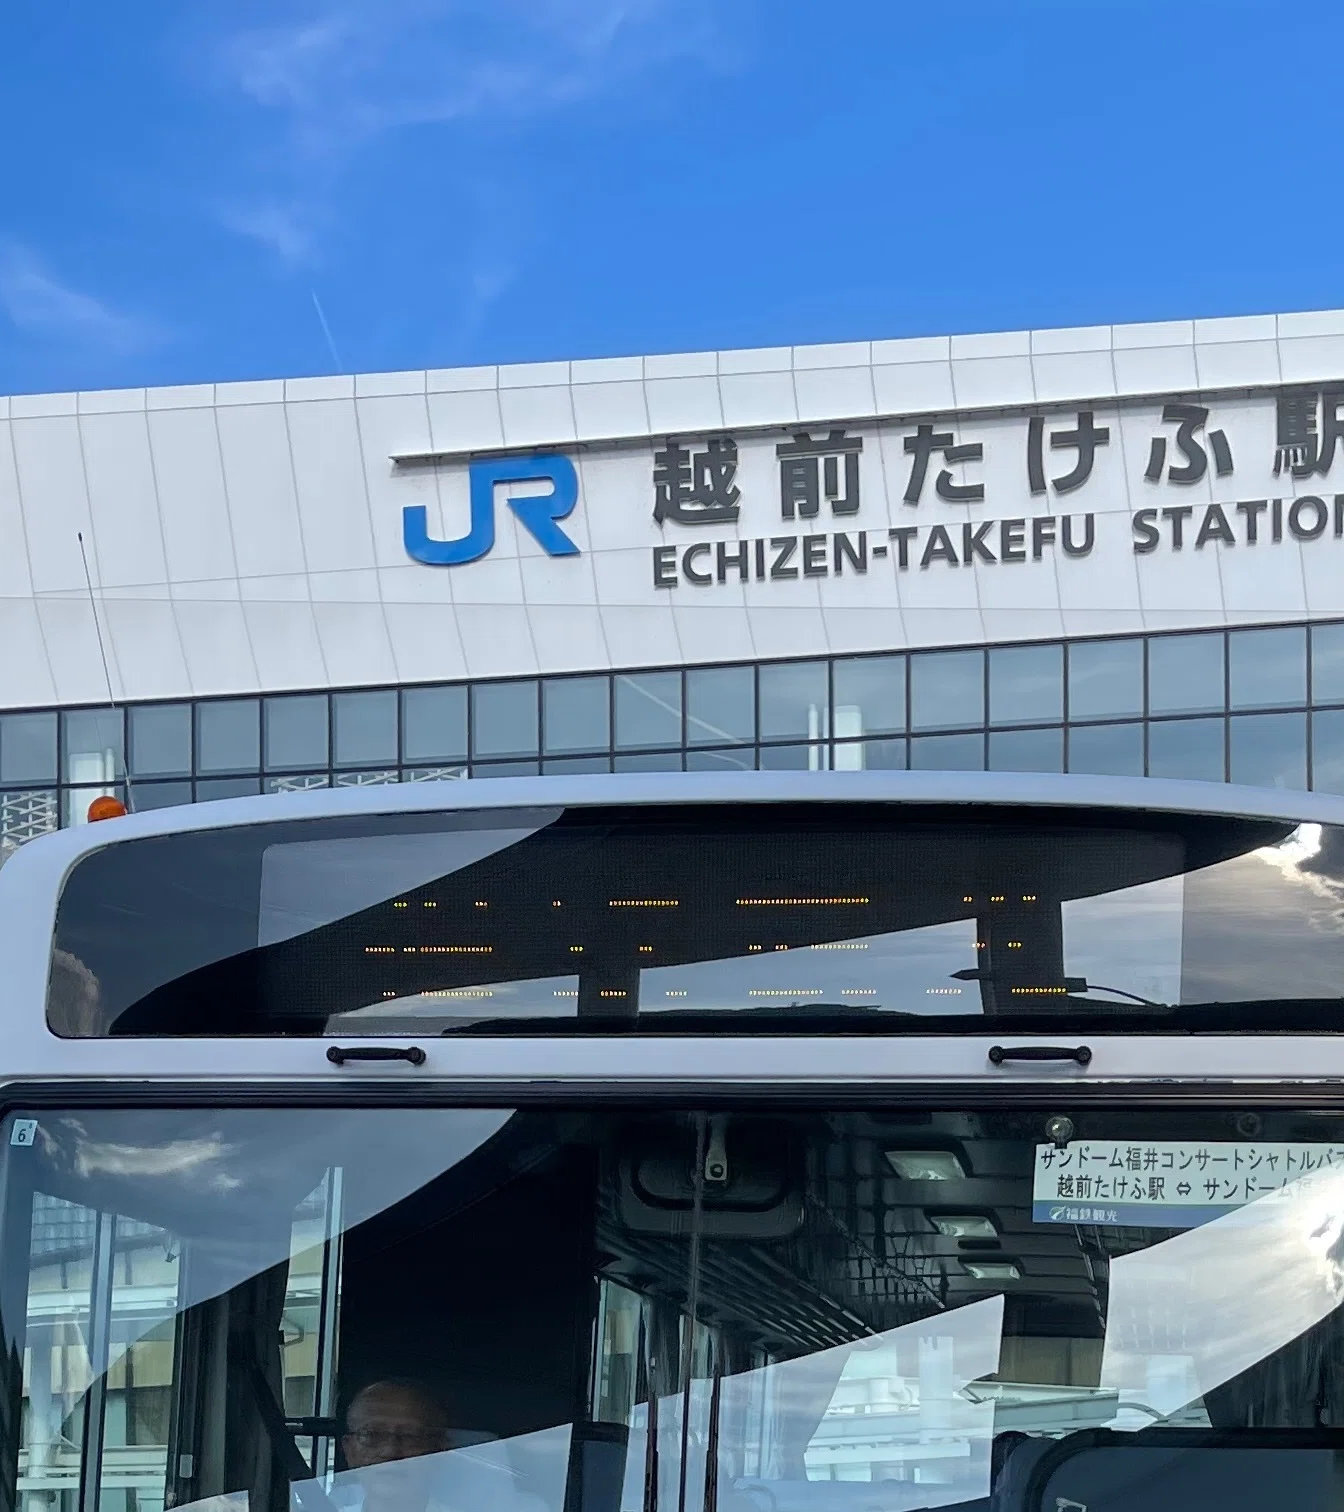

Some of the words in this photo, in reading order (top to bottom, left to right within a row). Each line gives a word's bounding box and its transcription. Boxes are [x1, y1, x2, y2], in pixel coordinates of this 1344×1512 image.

[403, 453, 582, 566] JR
[653, 511, 1095, 589] ECHIZEN-TAKEFU
[18, 1129, 26, 1142] 6
[1056, 1174, 1166, 1201] 越前たけふ駅
